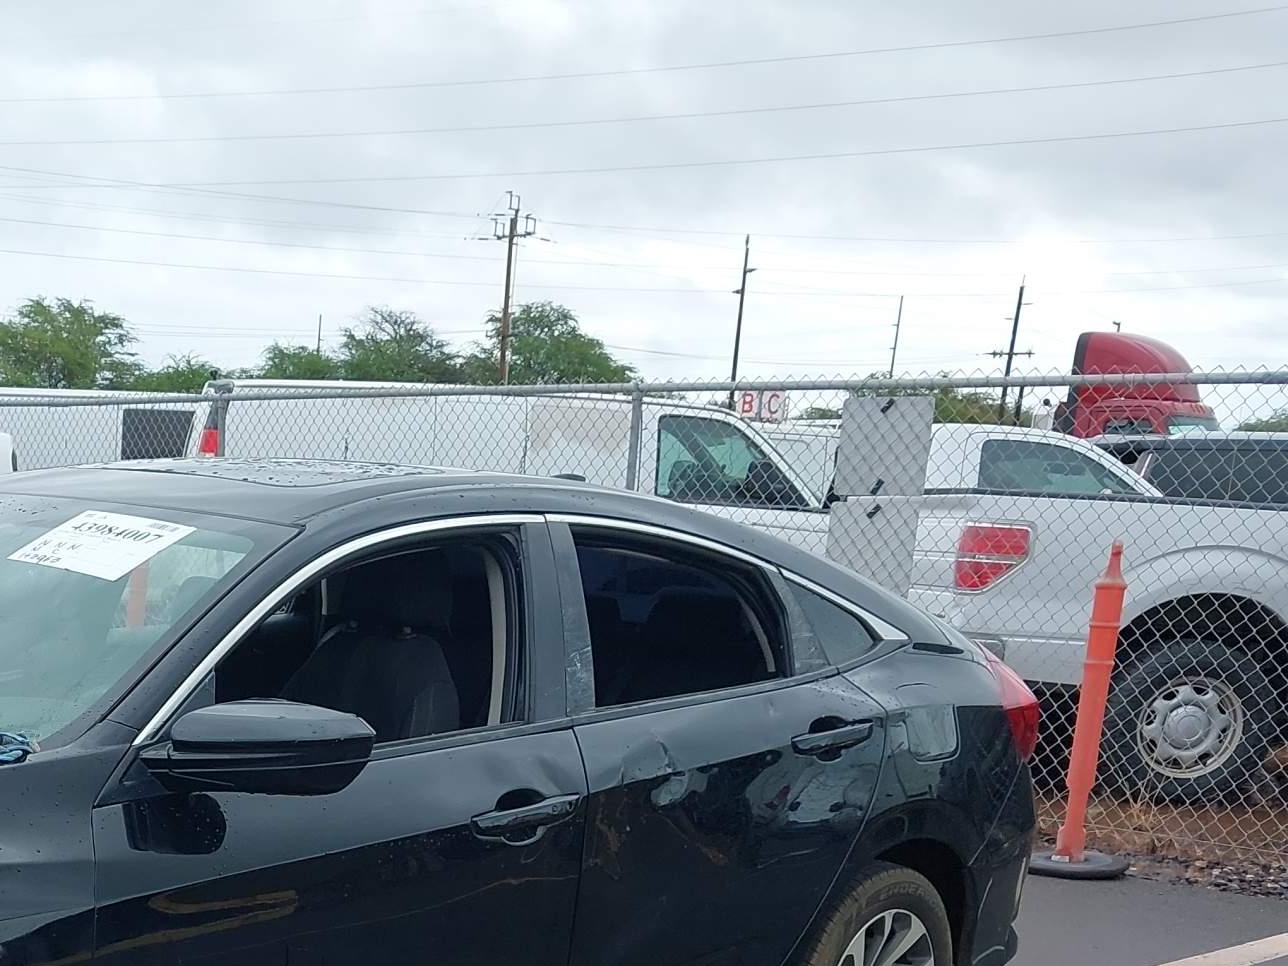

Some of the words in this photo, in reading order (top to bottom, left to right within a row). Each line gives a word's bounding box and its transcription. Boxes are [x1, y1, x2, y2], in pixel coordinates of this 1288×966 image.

[742, 393, 754, 413] B
[768, 393, 780, 414] C
[71, 521, 164, 544] 43984007
